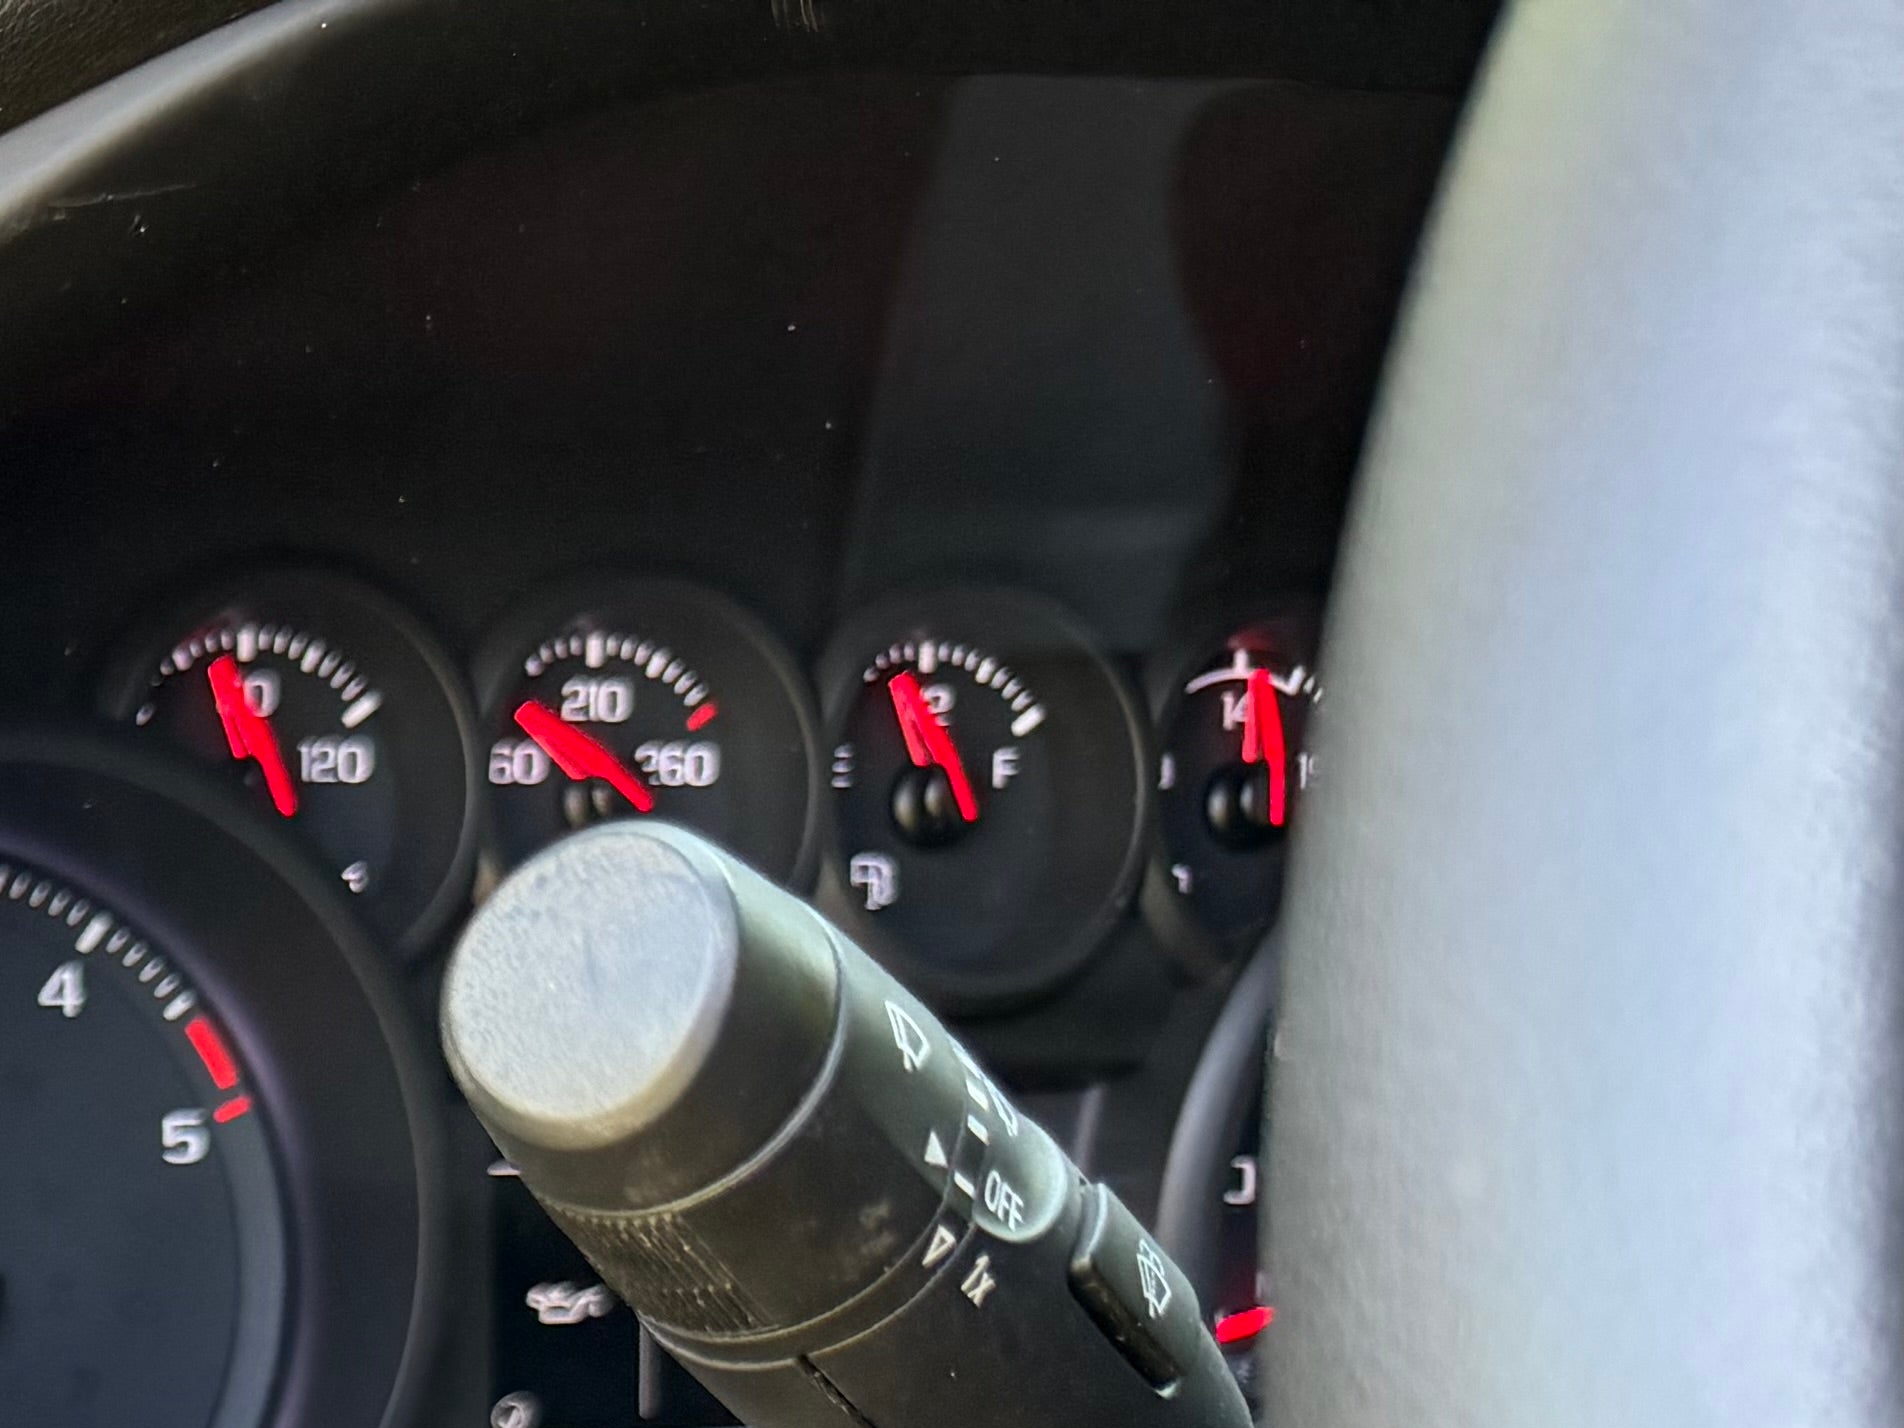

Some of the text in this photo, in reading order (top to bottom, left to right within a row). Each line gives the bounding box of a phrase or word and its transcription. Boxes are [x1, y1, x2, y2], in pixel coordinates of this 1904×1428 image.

[560, 675, 634, 723] 210
[297, 736, 376, 784] 120
[992, 746, 1021, 789] F
[38, 960, 87, 1018] 4
[161, 1109, 210, 1164] 5
[984, 1169, 1025, 1232] OFF
[960, 1254, 996, 1308] 1x
